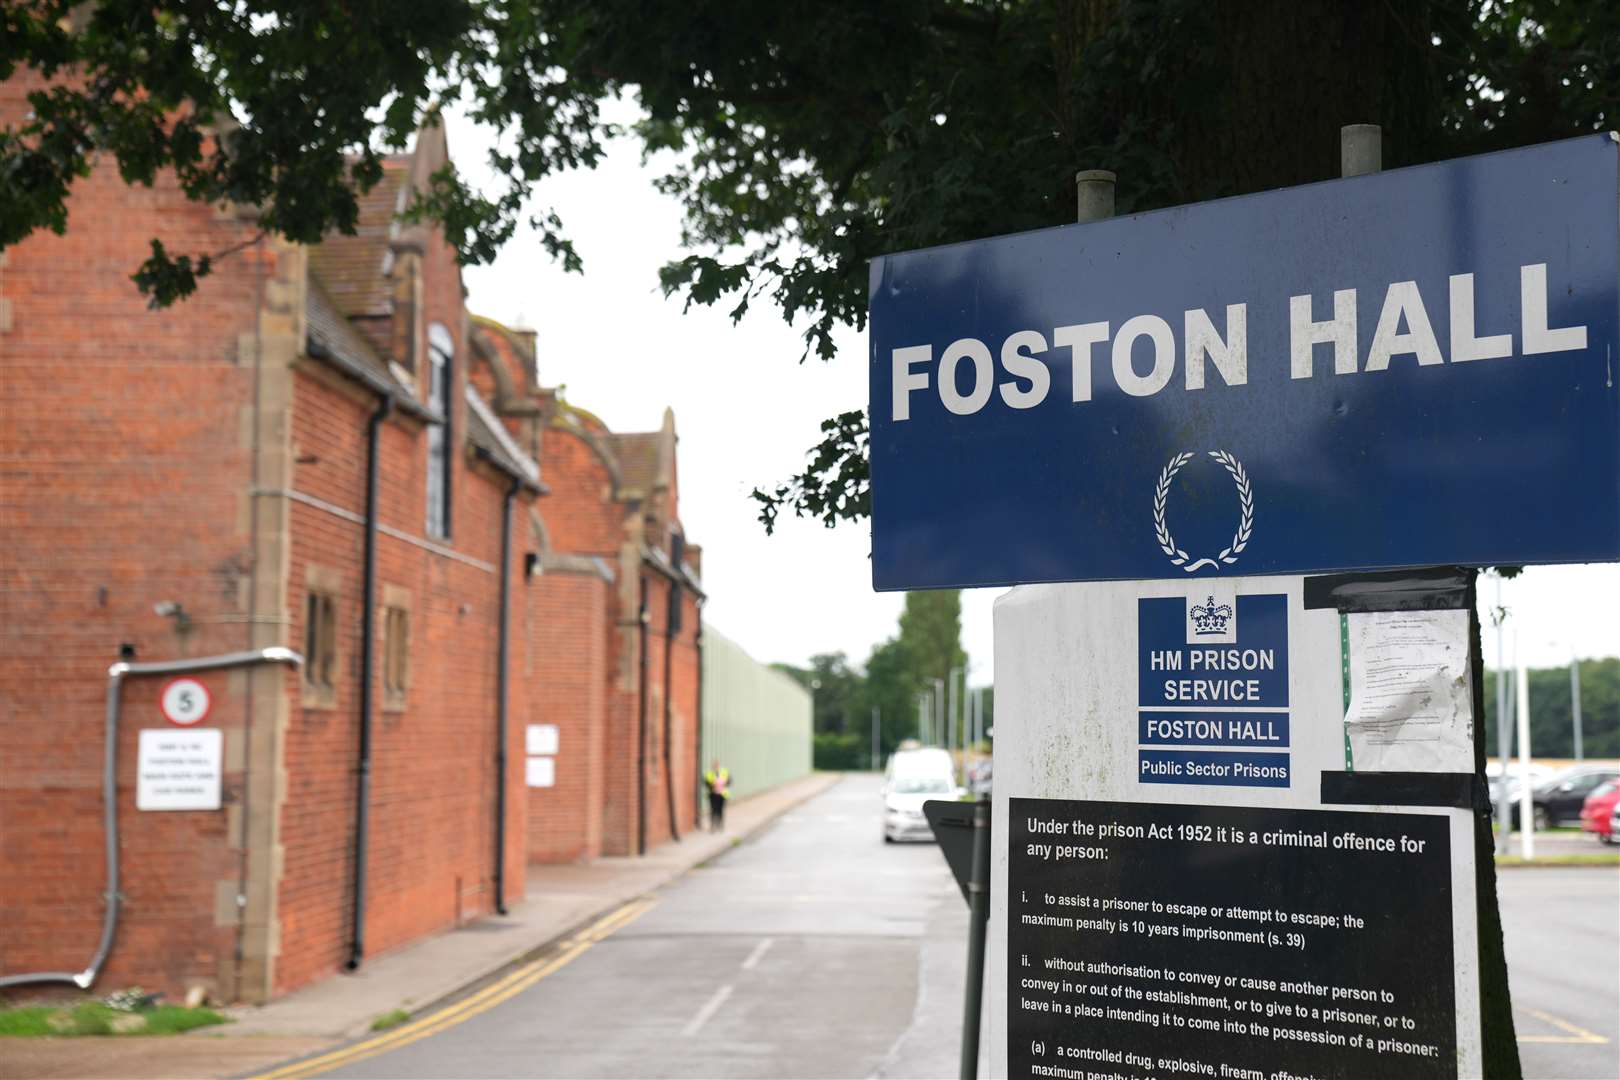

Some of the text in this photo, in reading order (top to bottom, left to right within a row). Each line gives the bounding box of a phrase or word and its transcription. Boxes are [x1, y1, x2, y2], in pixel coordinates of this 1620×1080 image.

[892, 262, 1588, 422] FOSTON HALL
[1151, 649, 1274, 671] HM PRISON
[179, 689, 194, 713] 5
[1164, 680, 1260, 700] SERVICE
[1147, 720, 1280, 740] FOSTON HALL
[1141, 760, 1287, 779] Public Sector Prisons
[1027, 844, 1108, 860] any person:
[1028, 818, 1425, 853] Under the prison Act 1952 it is a criminal offence for
[1022, 891, 1364, 928] i. to assist a prisoner to escape or attempt to escape; the
[1022, 914, 1305, 950] maximum penalty is 10 years imprisonment (s. 39)
[1022, 955, 1394, 1003] ii. without authorisation to convey or cause another person to
[1022, 979, 1415, 1029] convey in or out of the establishment, or to give to a prisoner, or to
[1022, 998, 1438, 1057] leave in a place intending it to come into the possession of a prisoner:
[1032, 1041, 1045, 1056] (a)
[1057, 1047, 1063, 1056] a
[1067, 1048, 1122, 1063] controlled
[1126, 1052, 1154, 1069] drug,
[1158, 1058, 1217, 1077] explosive,
[1032, 1065, 1083, 1080] maximum
[1088, 1072, 1127, 1080] penalt
